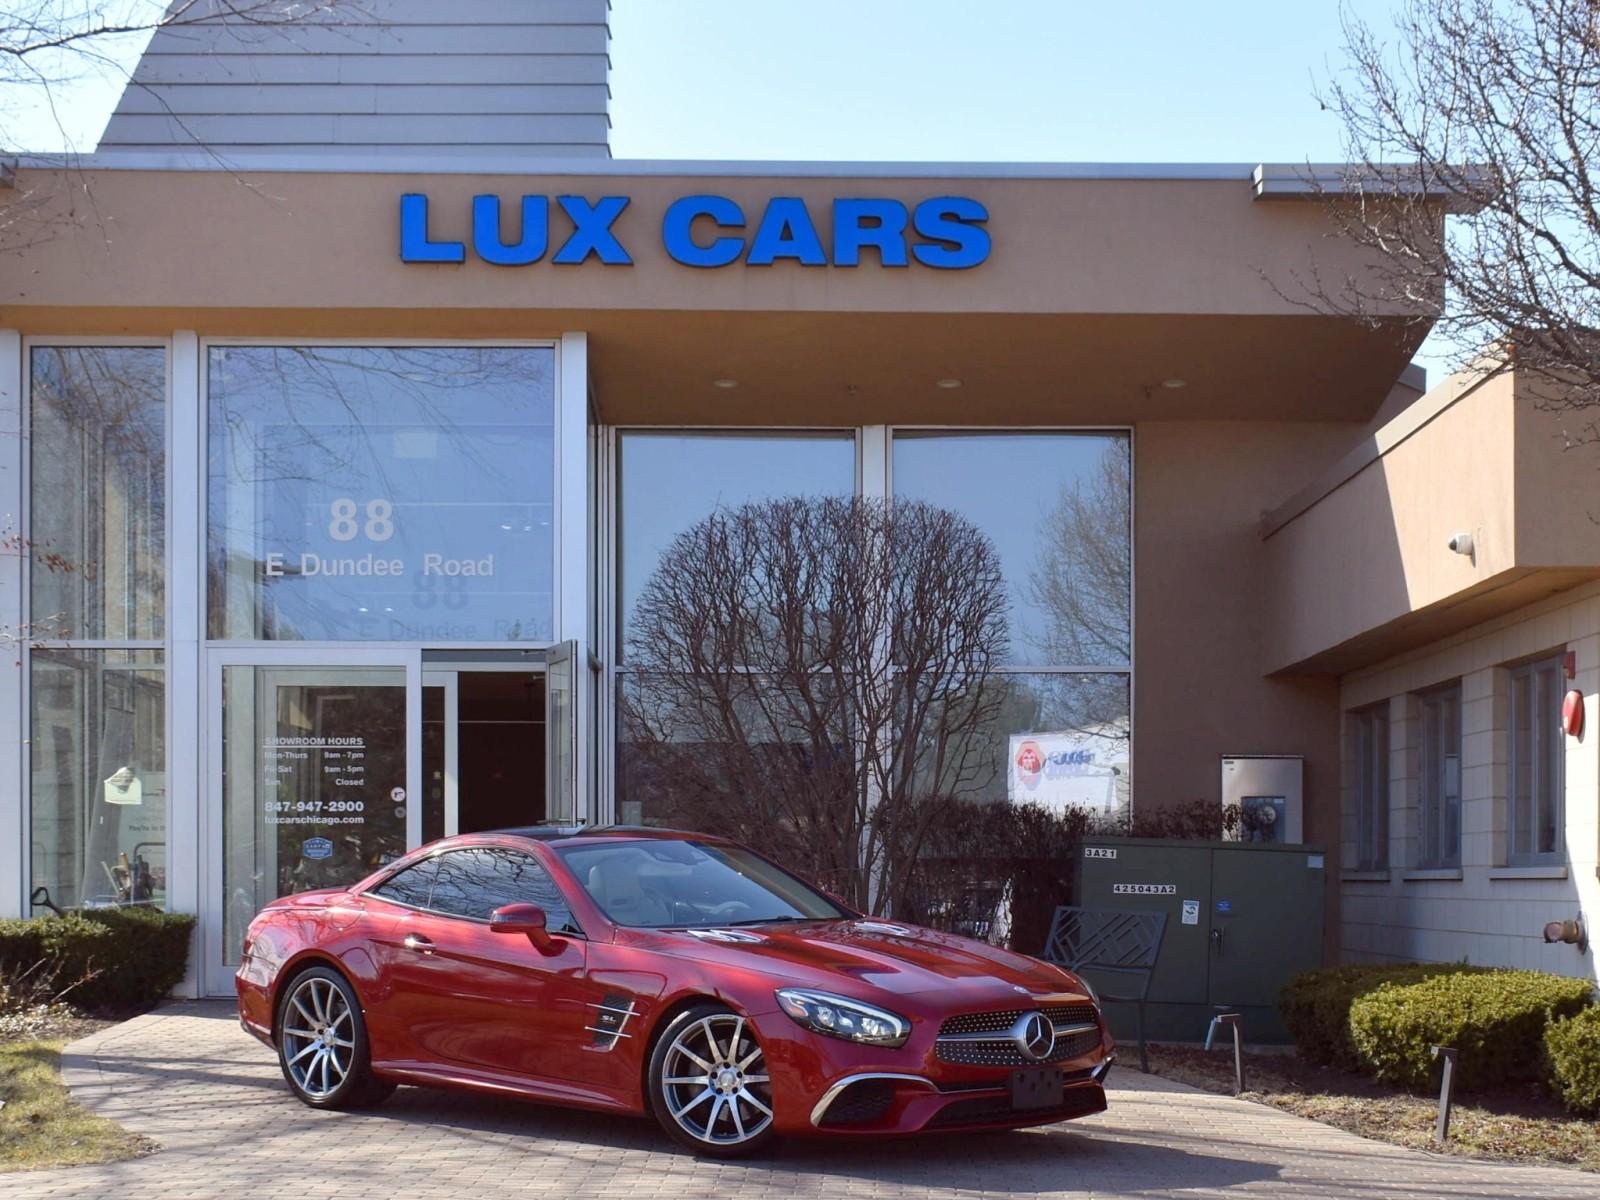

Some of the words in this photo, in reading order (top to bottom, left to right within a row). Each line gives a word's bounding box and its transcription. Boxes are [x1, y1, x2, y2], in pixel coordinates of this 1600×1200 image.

[400, 193, 634, 266] LUX
[662, 194, 992, 269] CARS
[328, 498, 394, 542] 88
[265, 553, 285, 577] E
[301, 553, 404, 577] Dundee
[423, 554, 495, 578] Road
[264, 737, 326, 746] SHOWROOM
[327, 737, 364, 746] HOURS
[347, 751, 364, 760] 7pm
[335, 778, 364, 786] Closed
[264, 801, 365, 812] 847-947-2900
[264, 815, 364, 825] luxcarschicago.com
[1085, 849, 1116, 858] 3A21
[1114, 885, 1176, 894] 425043A2
